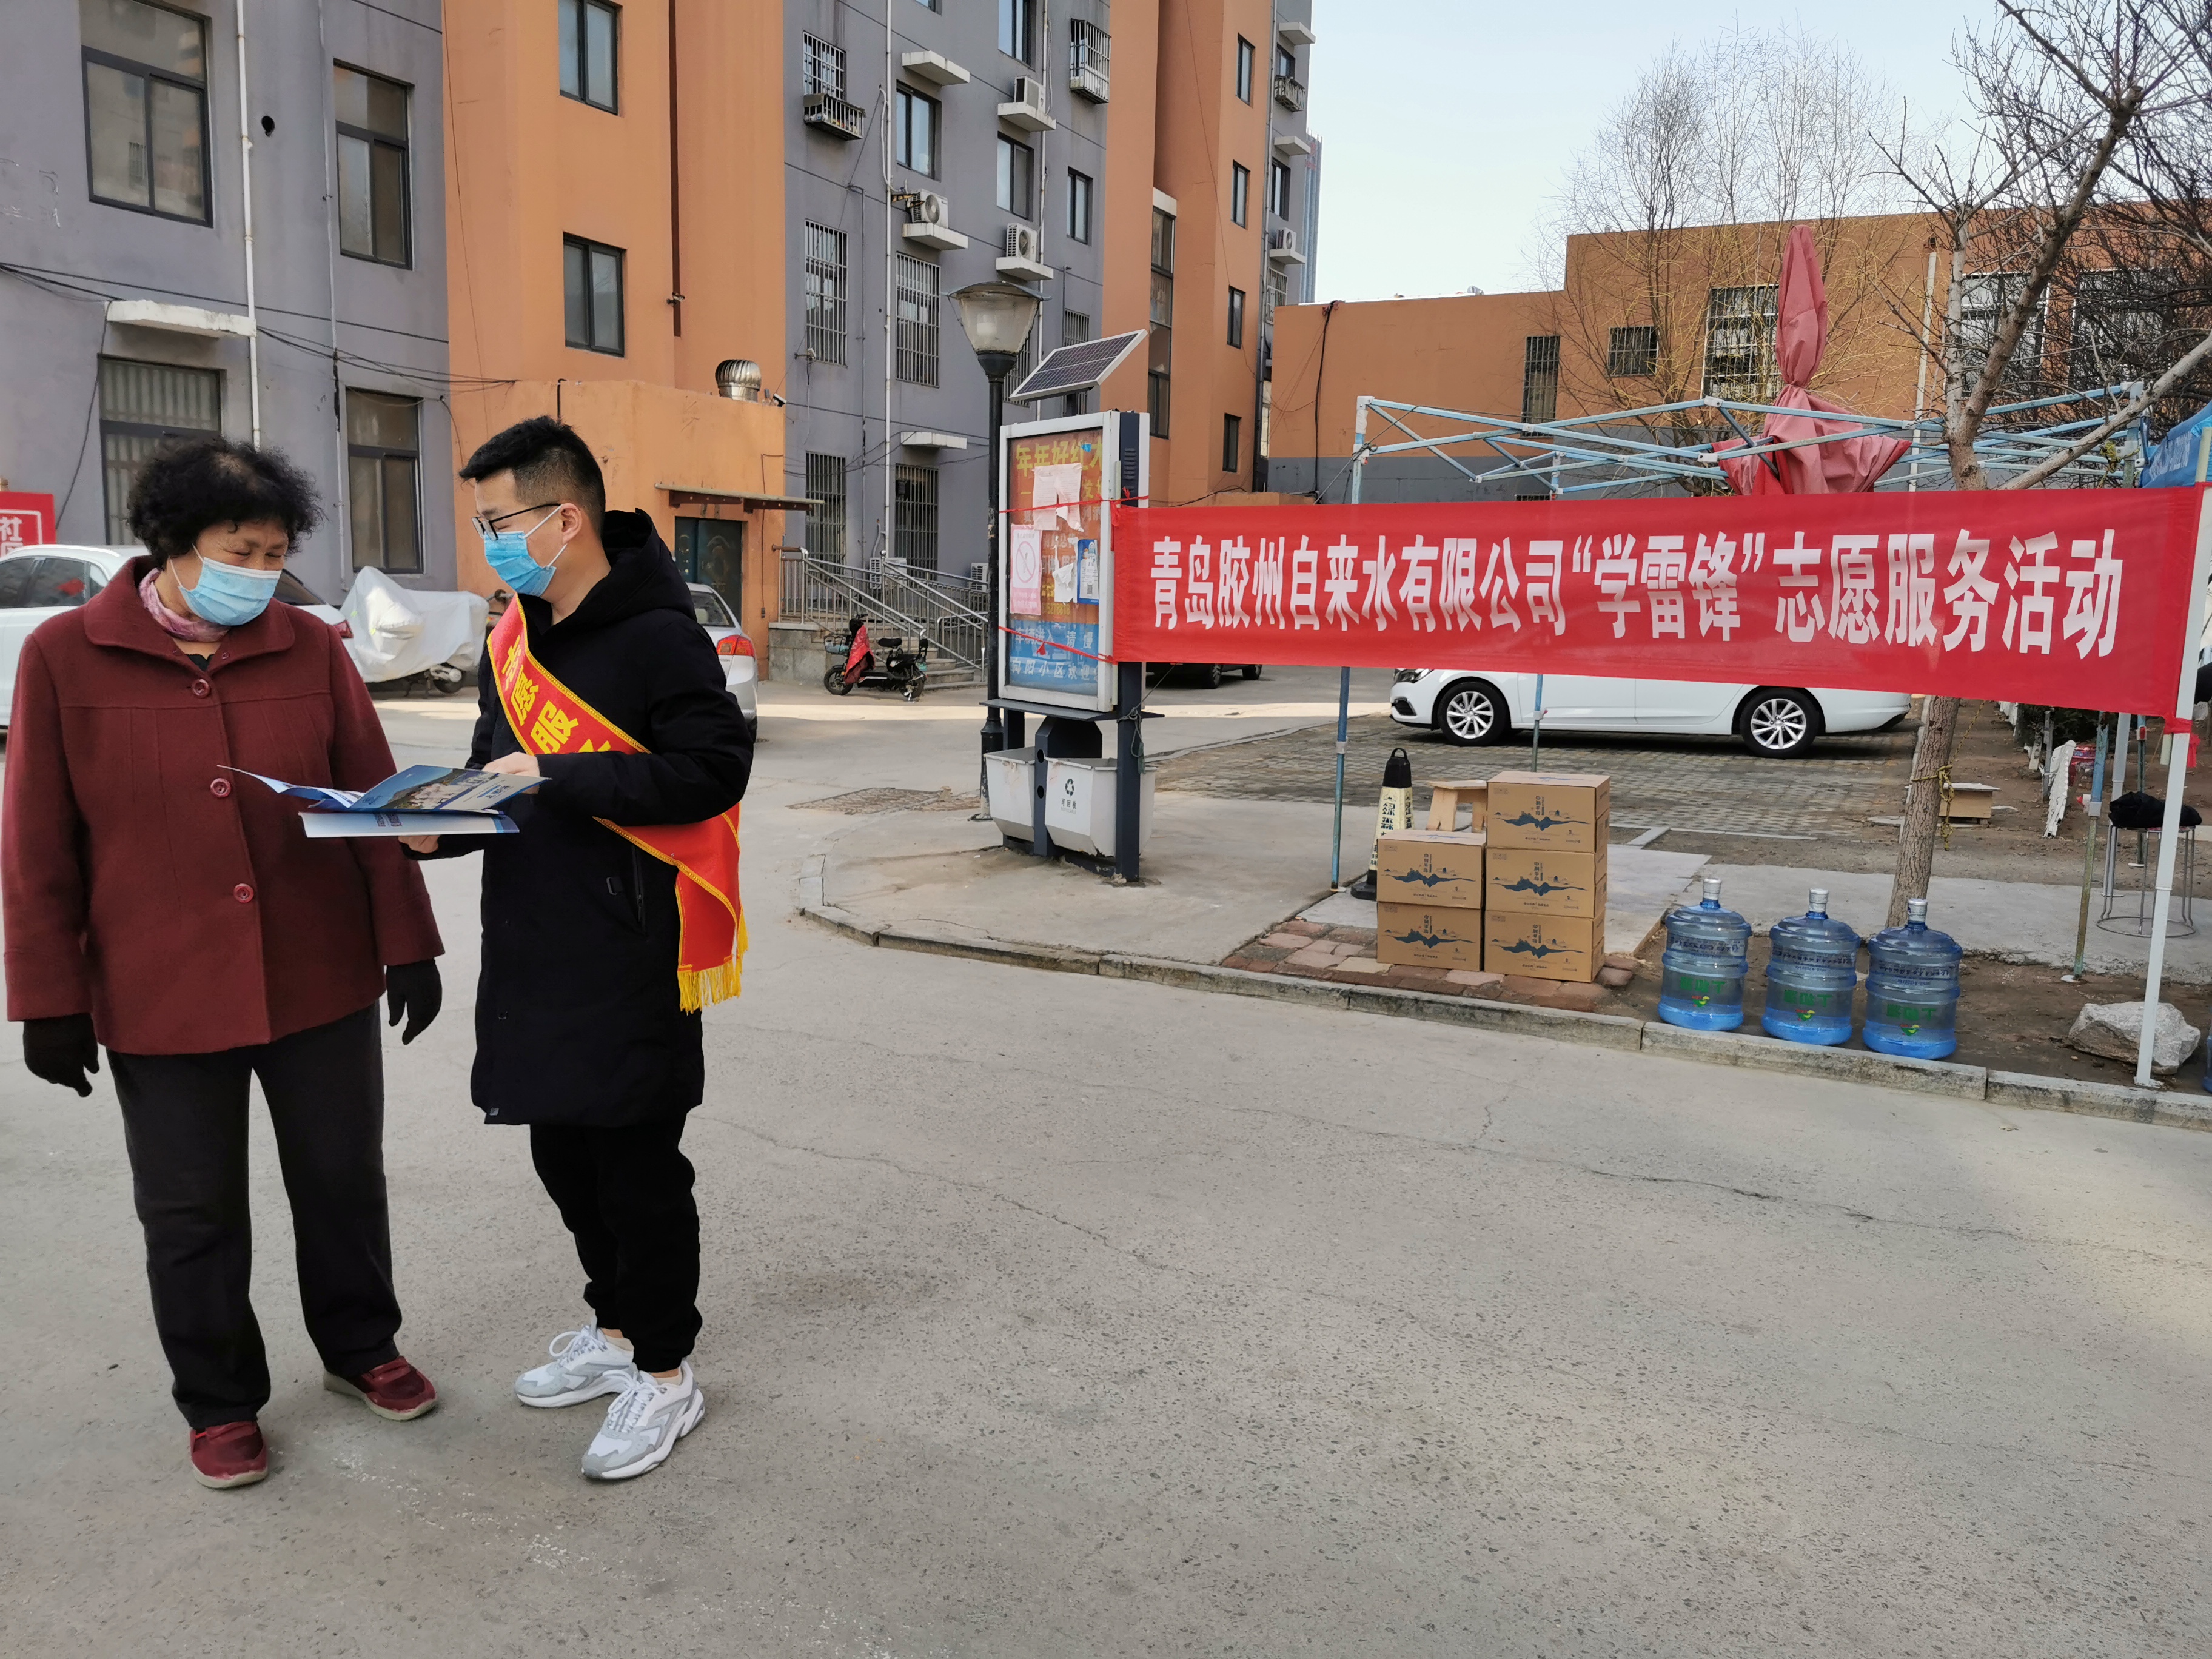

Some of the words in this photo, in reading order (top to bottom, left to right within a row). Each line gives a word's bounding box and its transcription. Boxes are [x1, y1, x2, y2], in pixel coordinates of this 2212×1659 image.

[1150, 528, 2123, 660] 青岛胶州自来水有限公司“学雷锋”志愿服务活动
[501, 634, 611, 754] 志愿服
